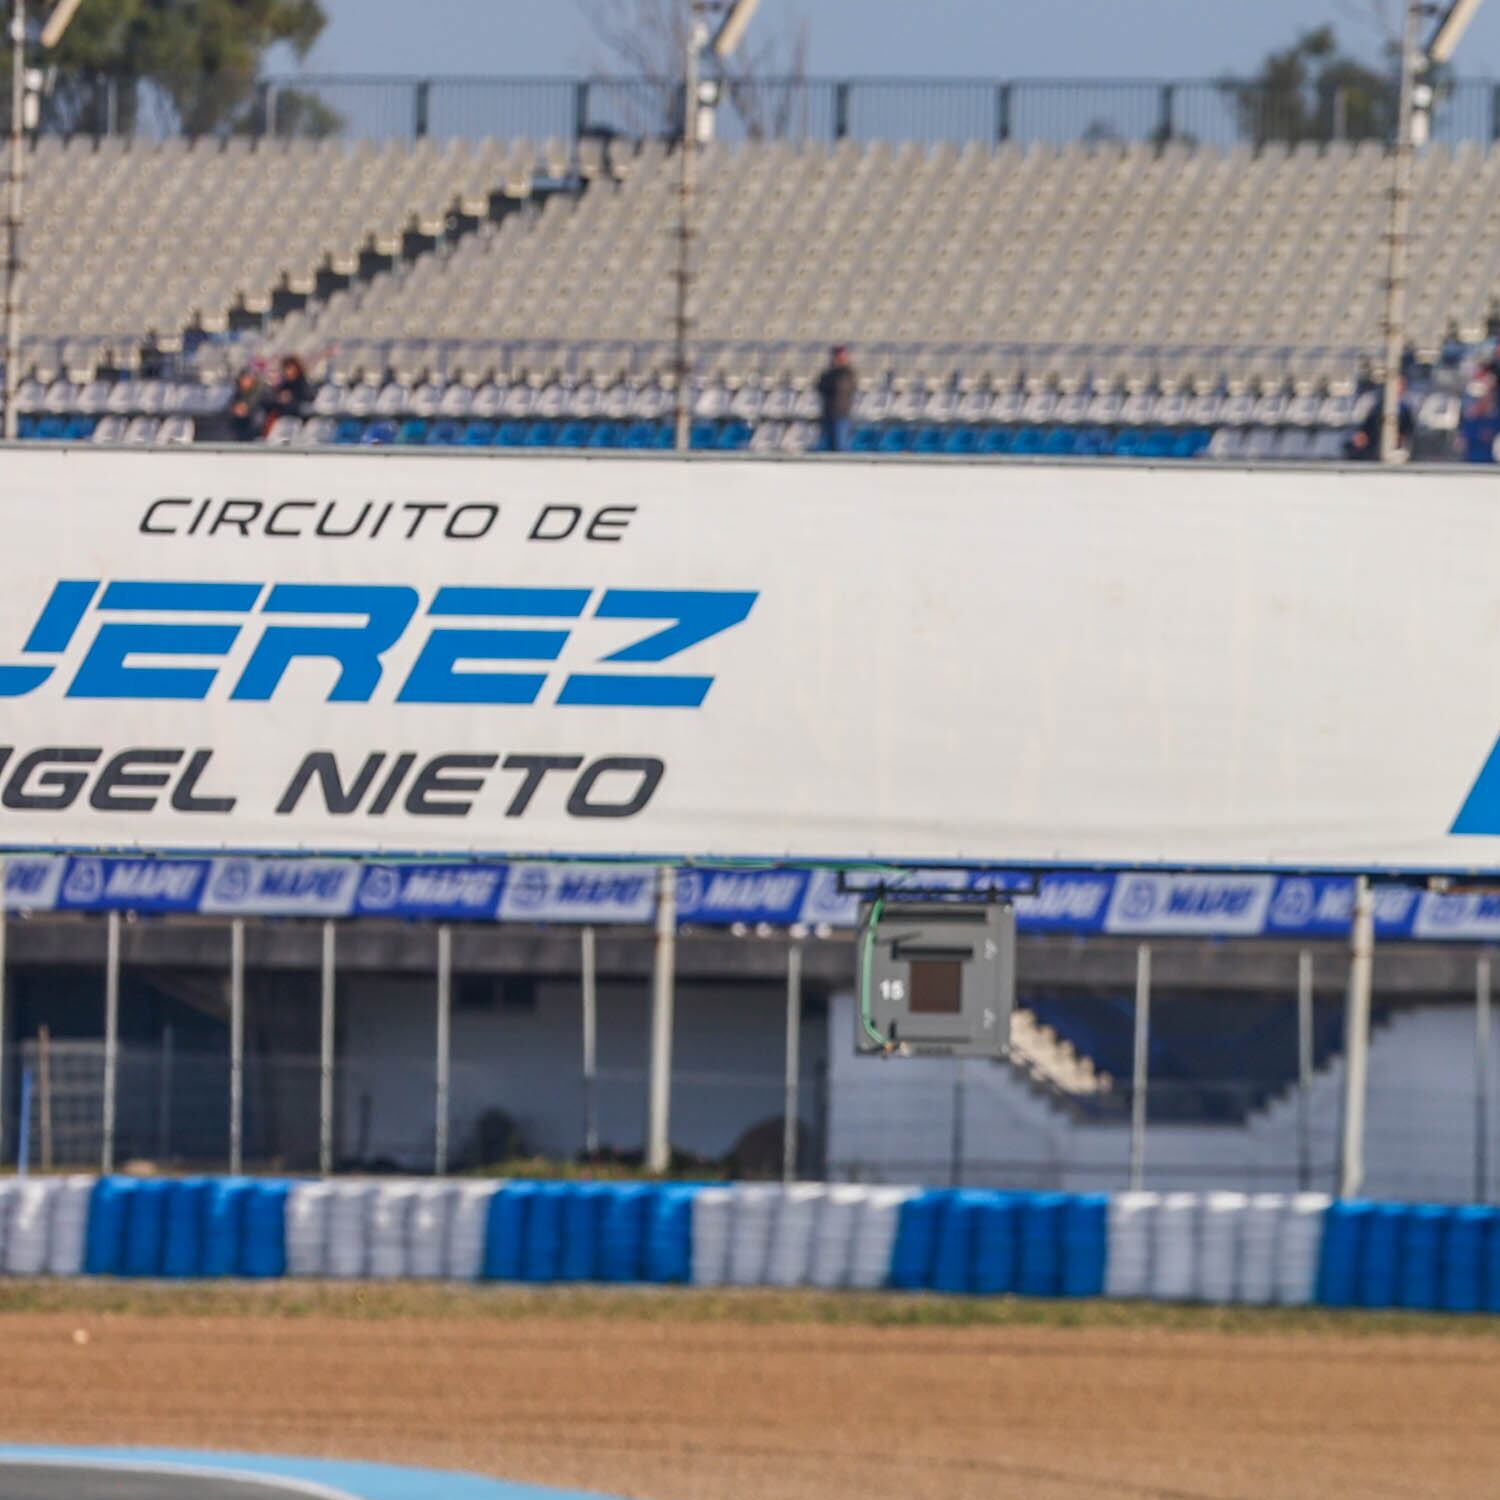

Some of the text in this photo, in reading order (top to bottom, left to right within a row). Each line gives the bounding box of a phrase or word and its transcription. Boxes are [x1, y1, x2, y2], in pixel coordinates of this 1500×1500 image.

[139, 497, 637, 542] CIRCUITO DE
[0, 746, 666, 818] GEL NIETO
